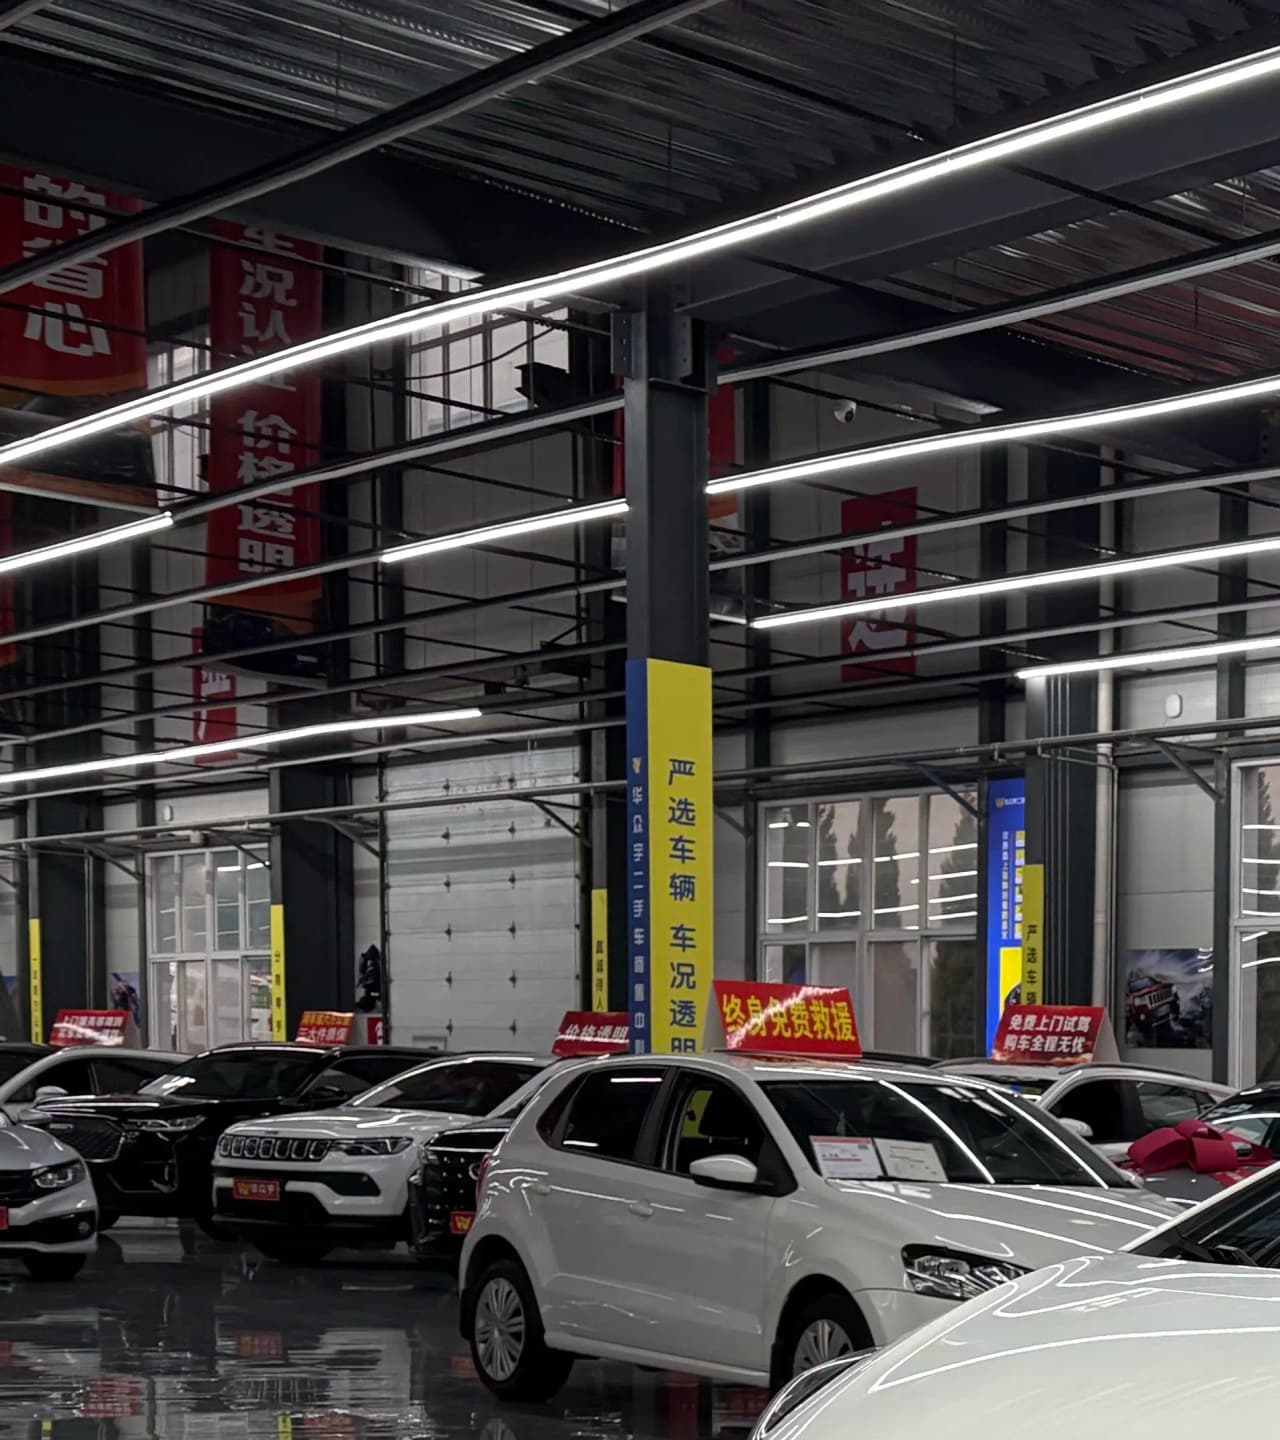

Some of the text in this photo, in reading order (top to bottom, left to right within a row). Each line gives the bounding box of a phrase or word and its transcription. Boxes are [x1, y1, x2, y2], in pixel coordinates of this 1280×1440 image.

[667, 757, 697, 1054] 严选车辆 车况透明
[723, 994, 855, 1041] 终身免费救援
[1008, 1014, 1092, 1033] 免费上门试驾
[1003, 1034, 1086, 1053] 购车全程无忧
